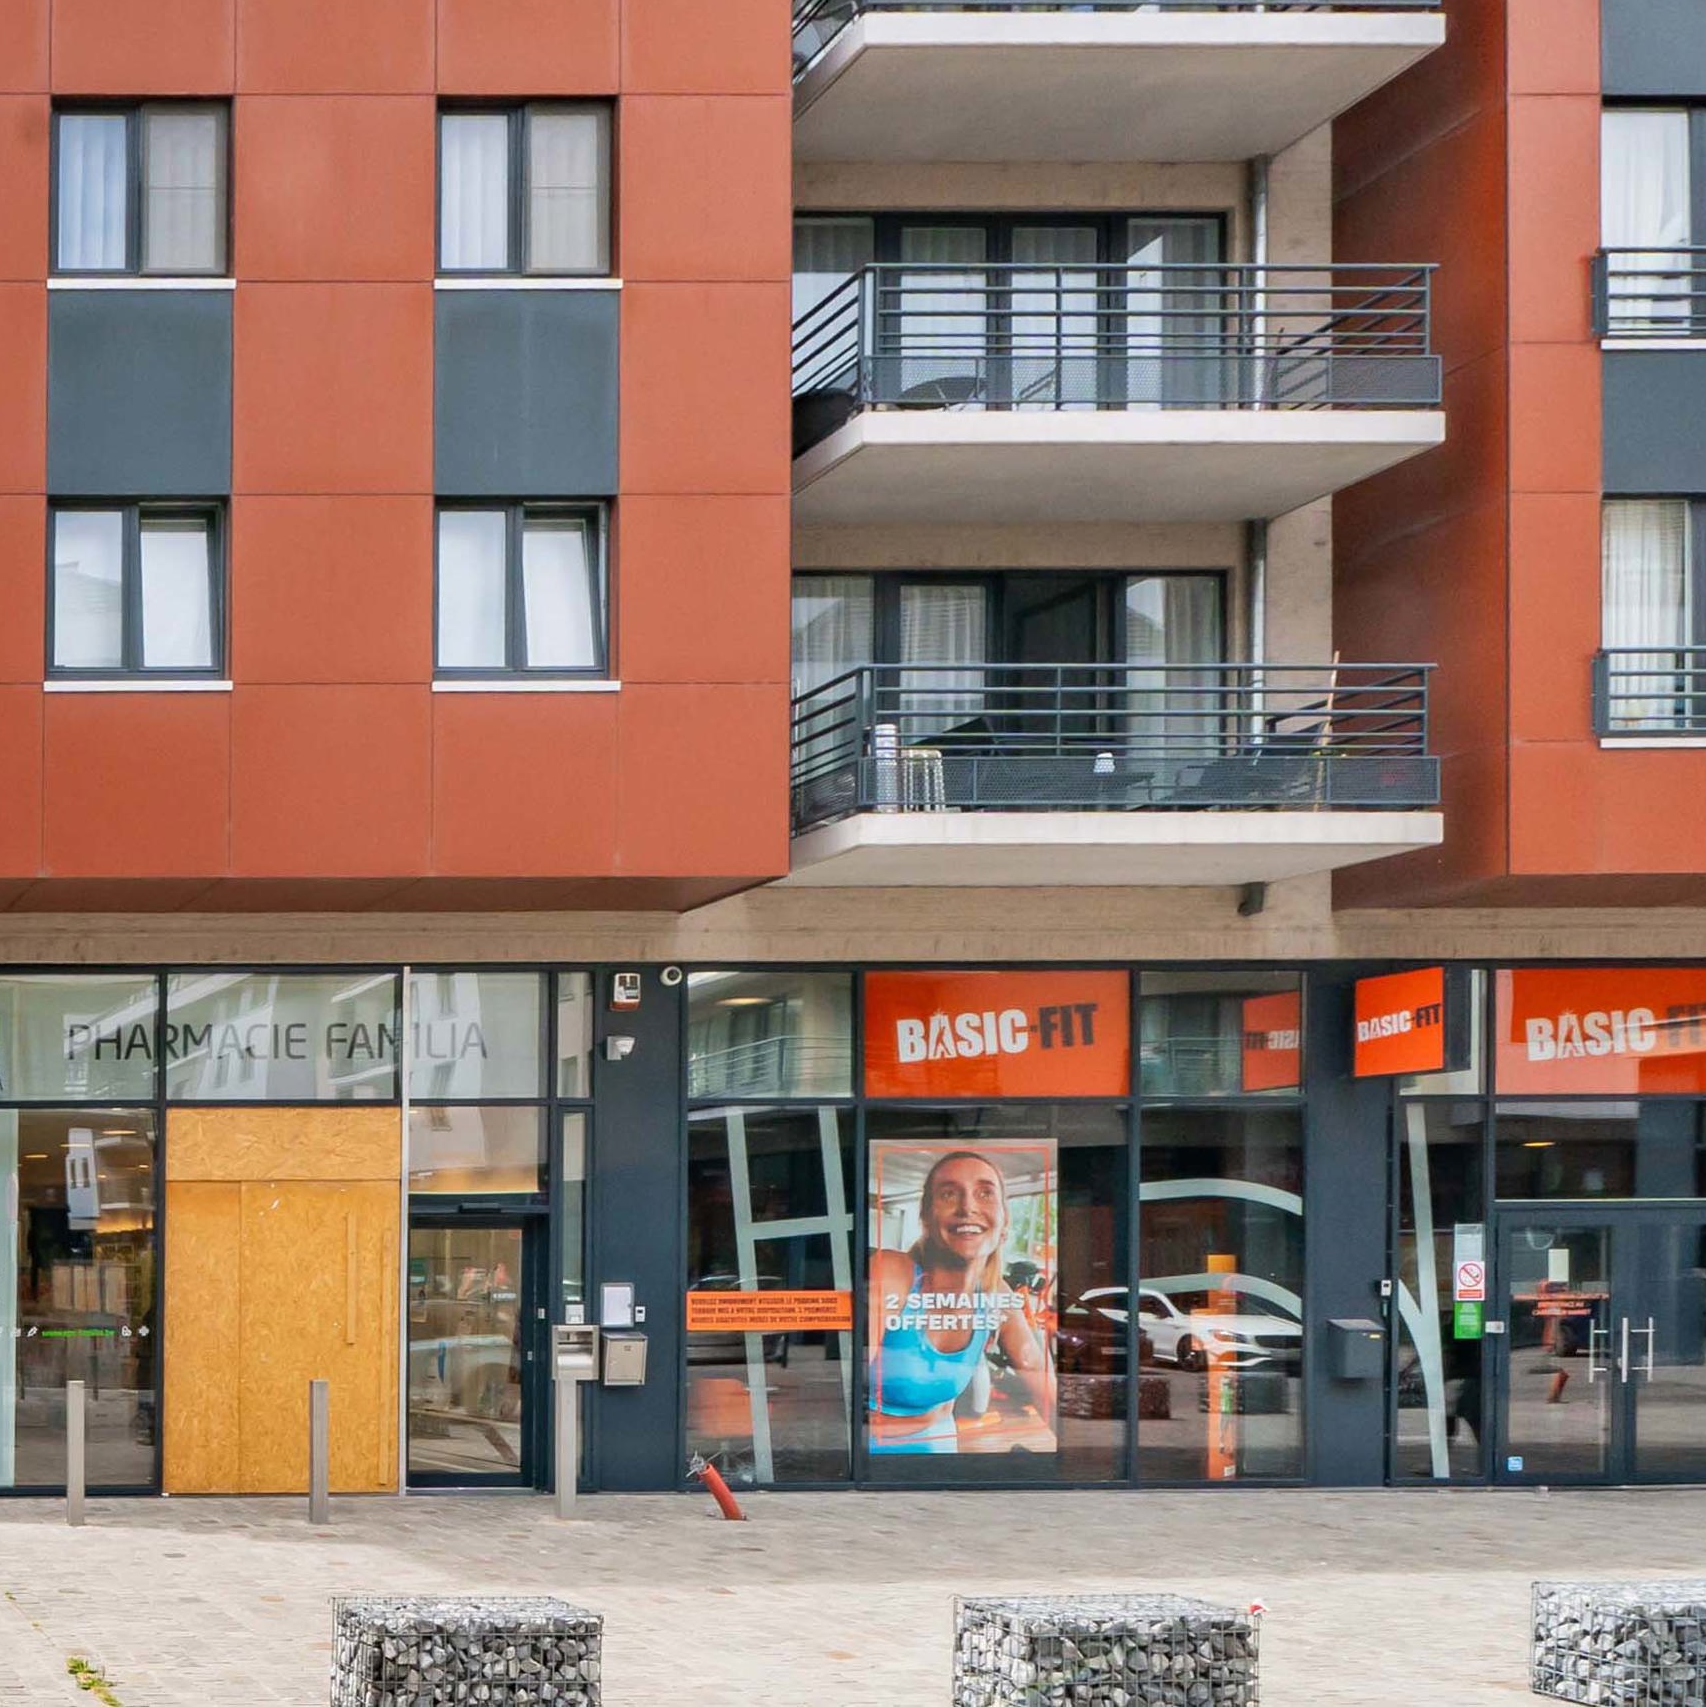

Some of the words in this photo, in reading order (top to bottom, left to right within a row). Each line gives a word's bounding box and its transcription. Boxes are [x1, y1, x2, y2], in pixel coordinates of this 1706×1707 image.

[67, 1023, 306, 1061] PHARMACIE
[896, 1002, 1099, 1063] BASIC-FIT
[1357, 1002, 1442, 1043] BASIC-FIT
[885, 1294, 900, 1310] 2
[906, 1292, 1026, 1310] SEMAINES
